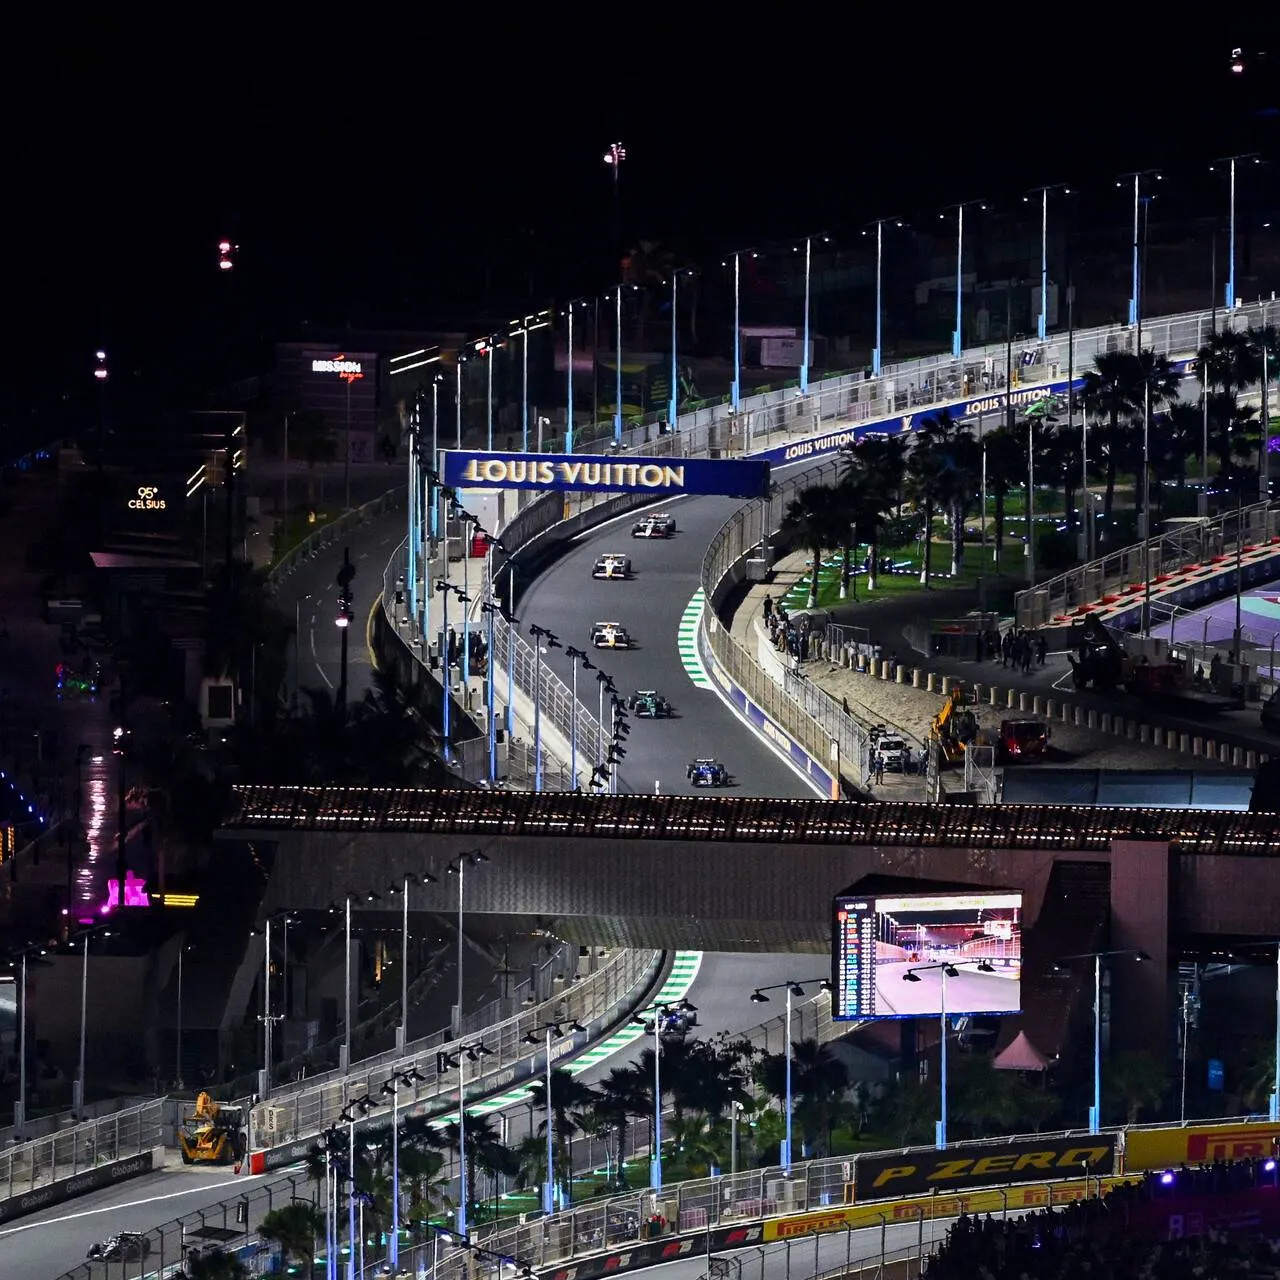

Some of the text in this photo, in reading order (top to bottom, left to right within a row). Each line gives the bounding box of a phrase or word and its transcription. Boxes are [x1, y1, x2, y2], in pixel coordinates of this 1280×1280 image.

[965, 397, 1000, 417] LOUIS
[785, 431, 856, 460] LOUIS VUITTON
[464, 459, 686, 488] LOUIS VUITTON
[127, 499, 167, 510] CELSIUS
[873, 1146, 1112, 1188] P ZERO
[776, 1212, 847, 1237] PIRELLI
